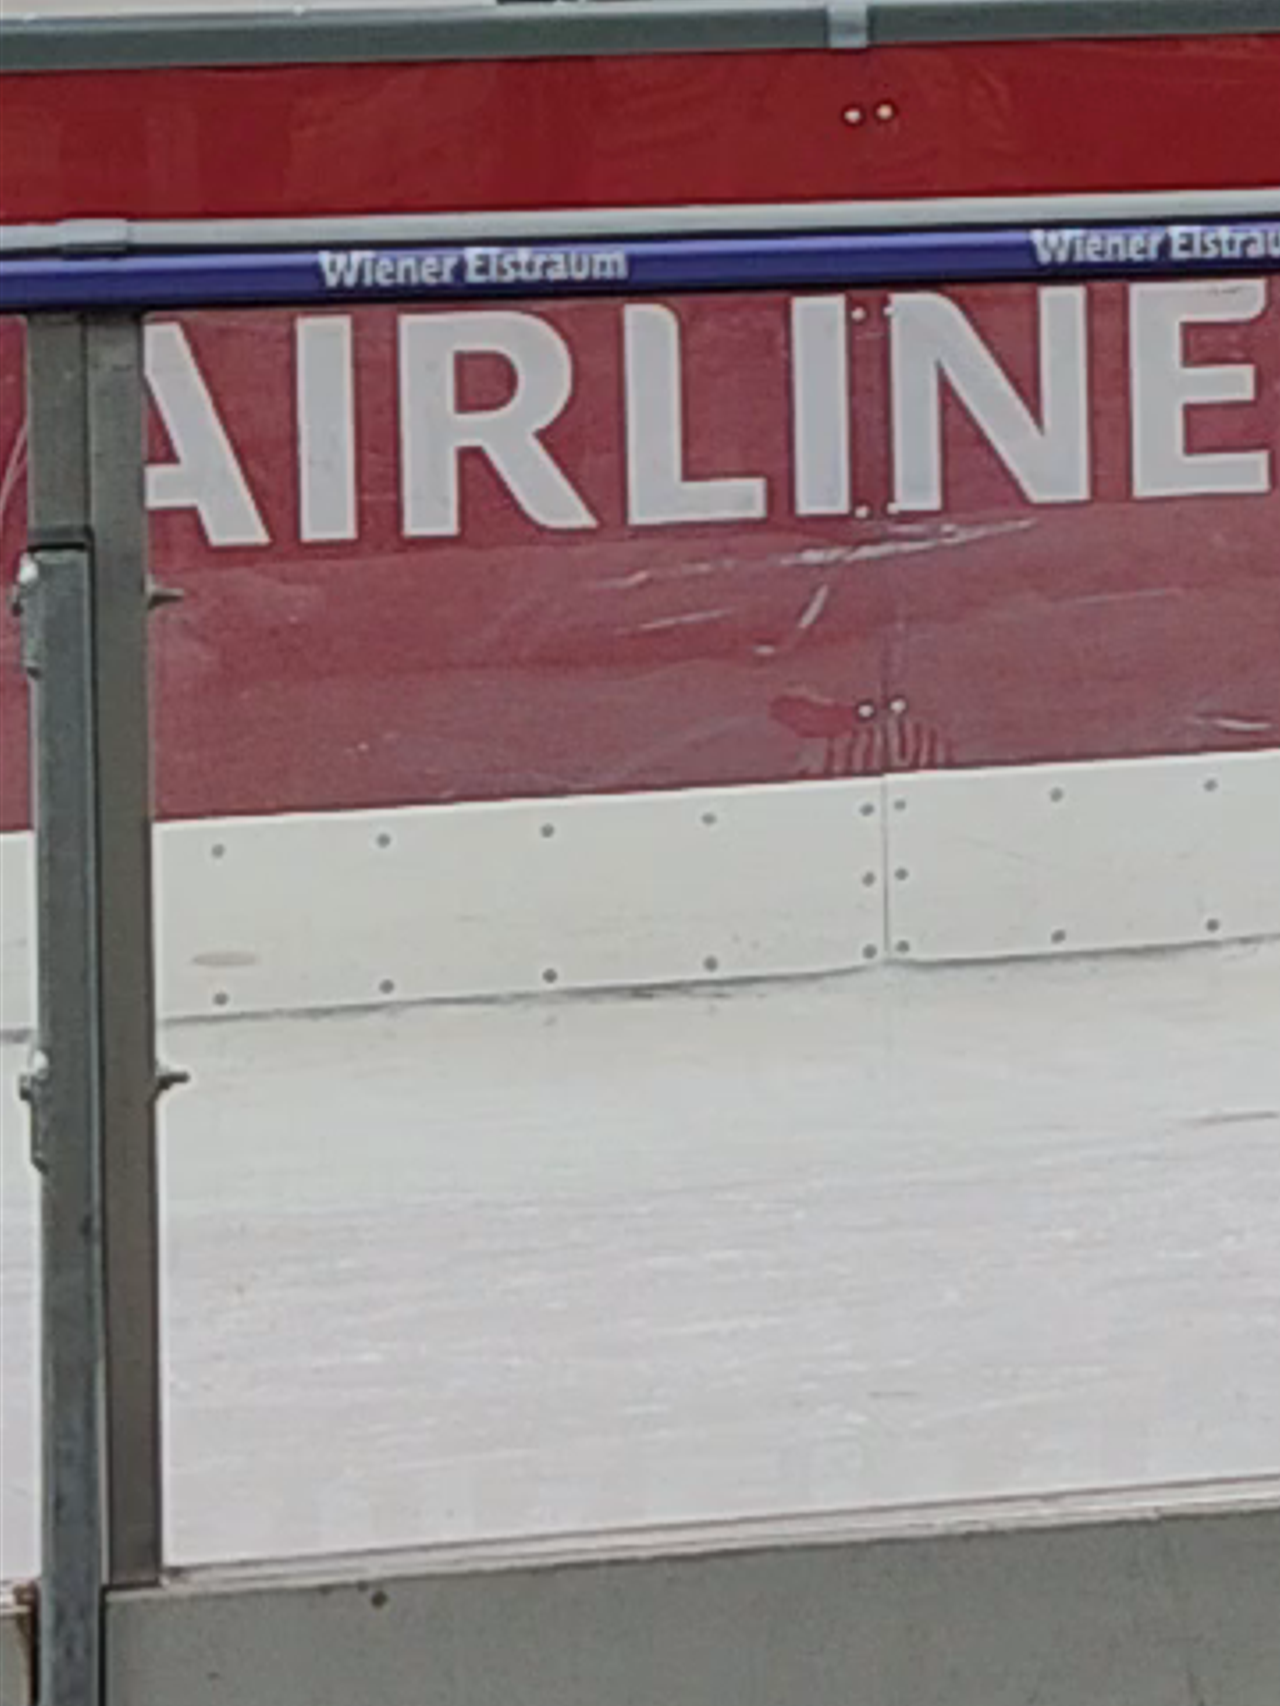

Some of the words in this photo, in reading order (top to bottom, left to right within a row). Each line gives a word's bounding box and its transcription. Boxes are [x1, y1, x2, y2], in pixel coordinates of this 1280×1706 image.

[1029, 229, 1163, 264] Wiener
[318, 250, 458, 286] Wiener
[463, 246, 629, 284] Eistraum
